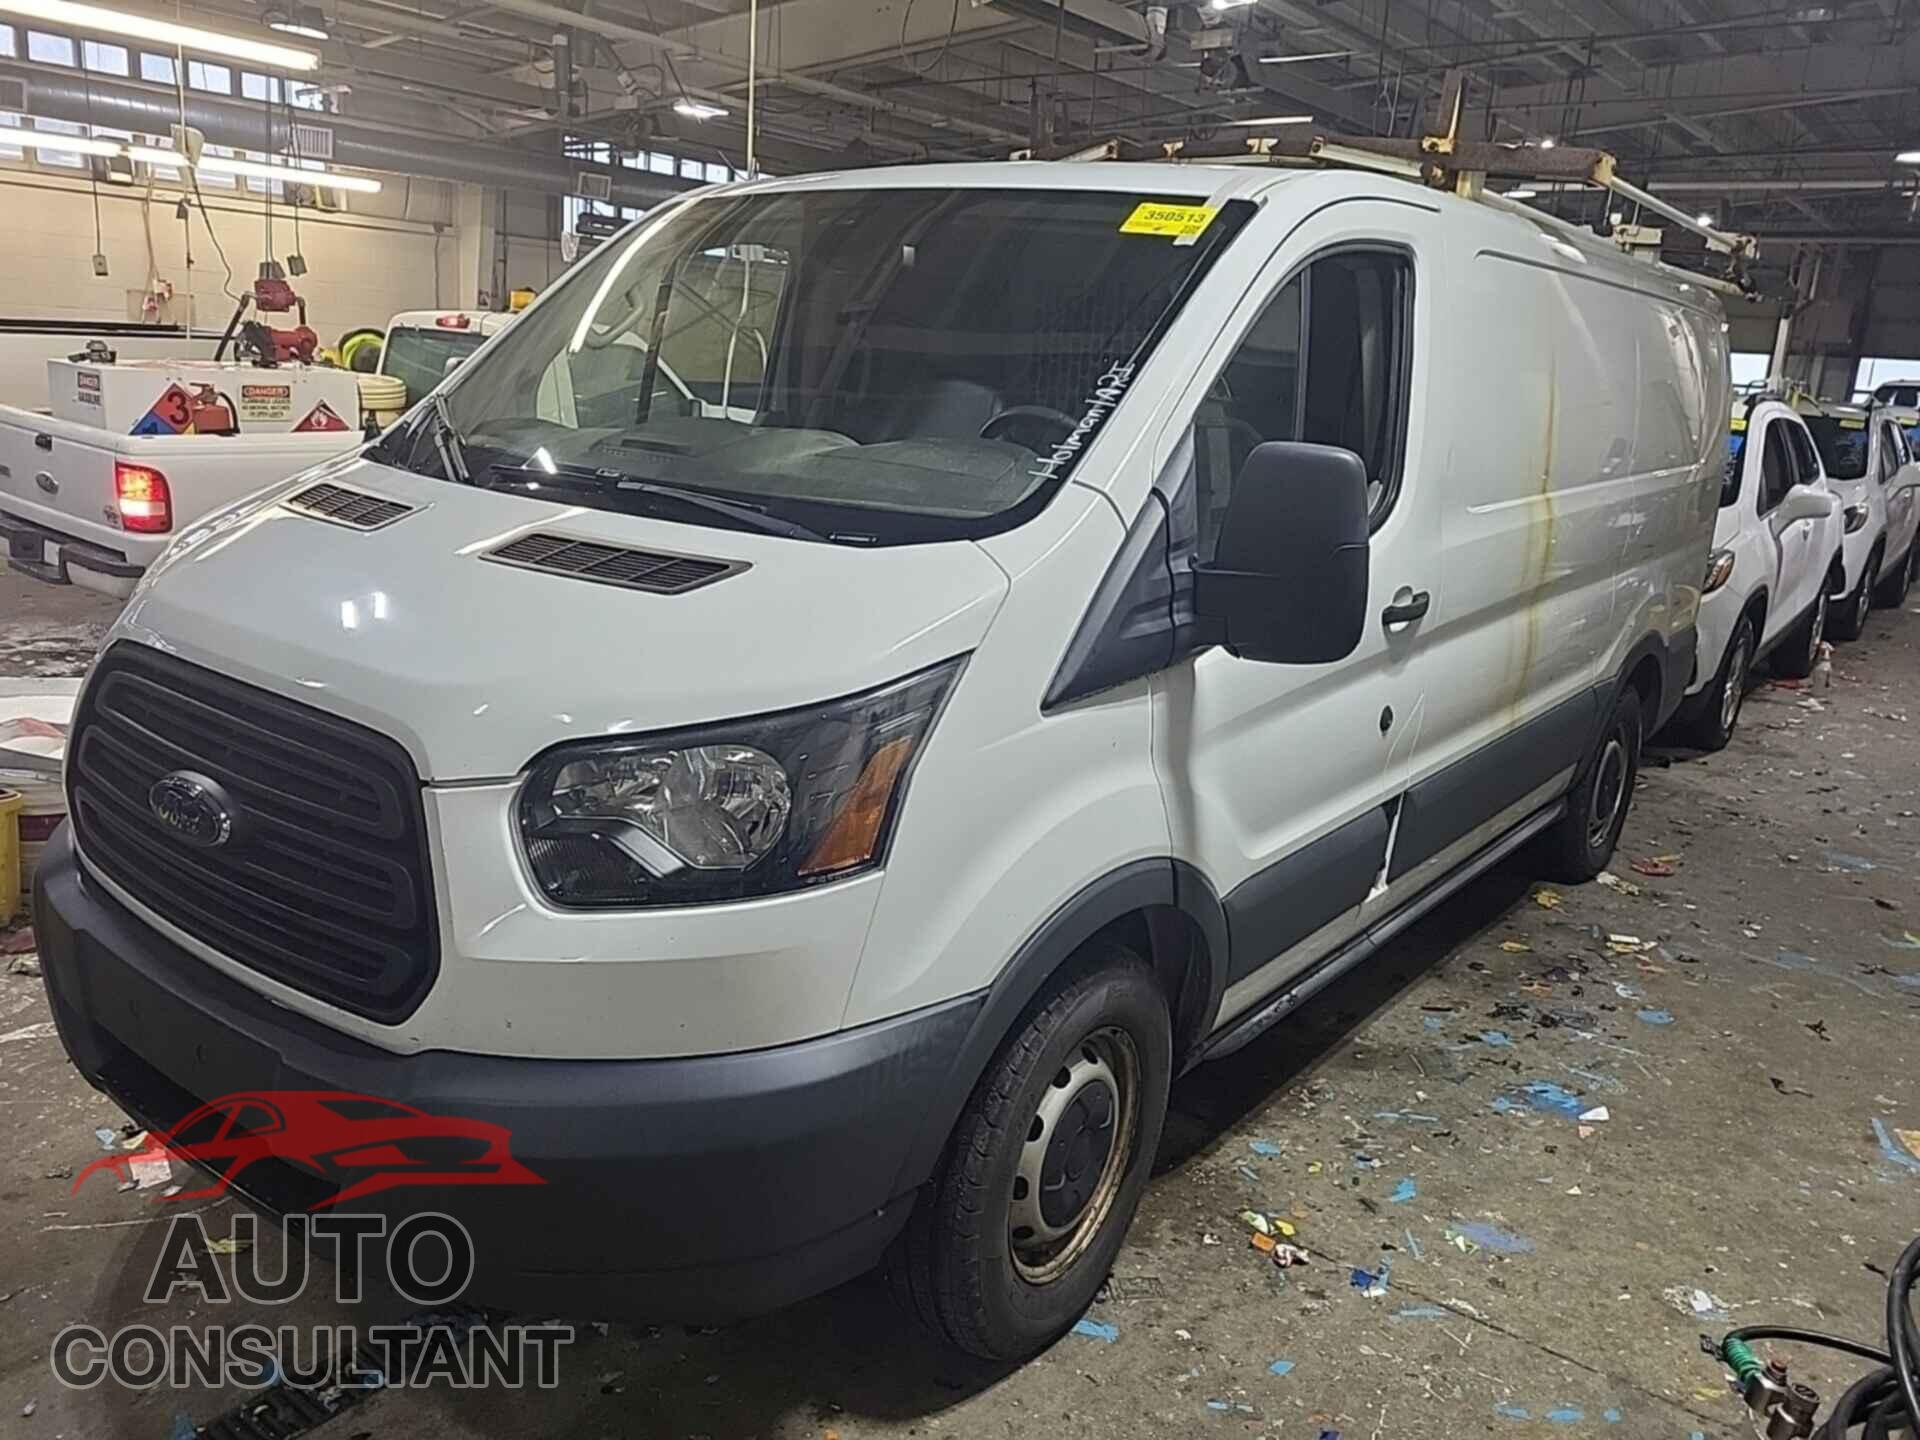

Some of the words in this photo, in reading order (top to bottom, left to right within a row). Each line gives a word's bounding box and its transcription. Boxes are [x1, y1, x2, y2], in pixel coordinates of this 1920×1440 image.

[1143, 210, 1206, 223] 350513
[248, 386, 283, 396] DANGER
[168, 391, 189, 425] 3
